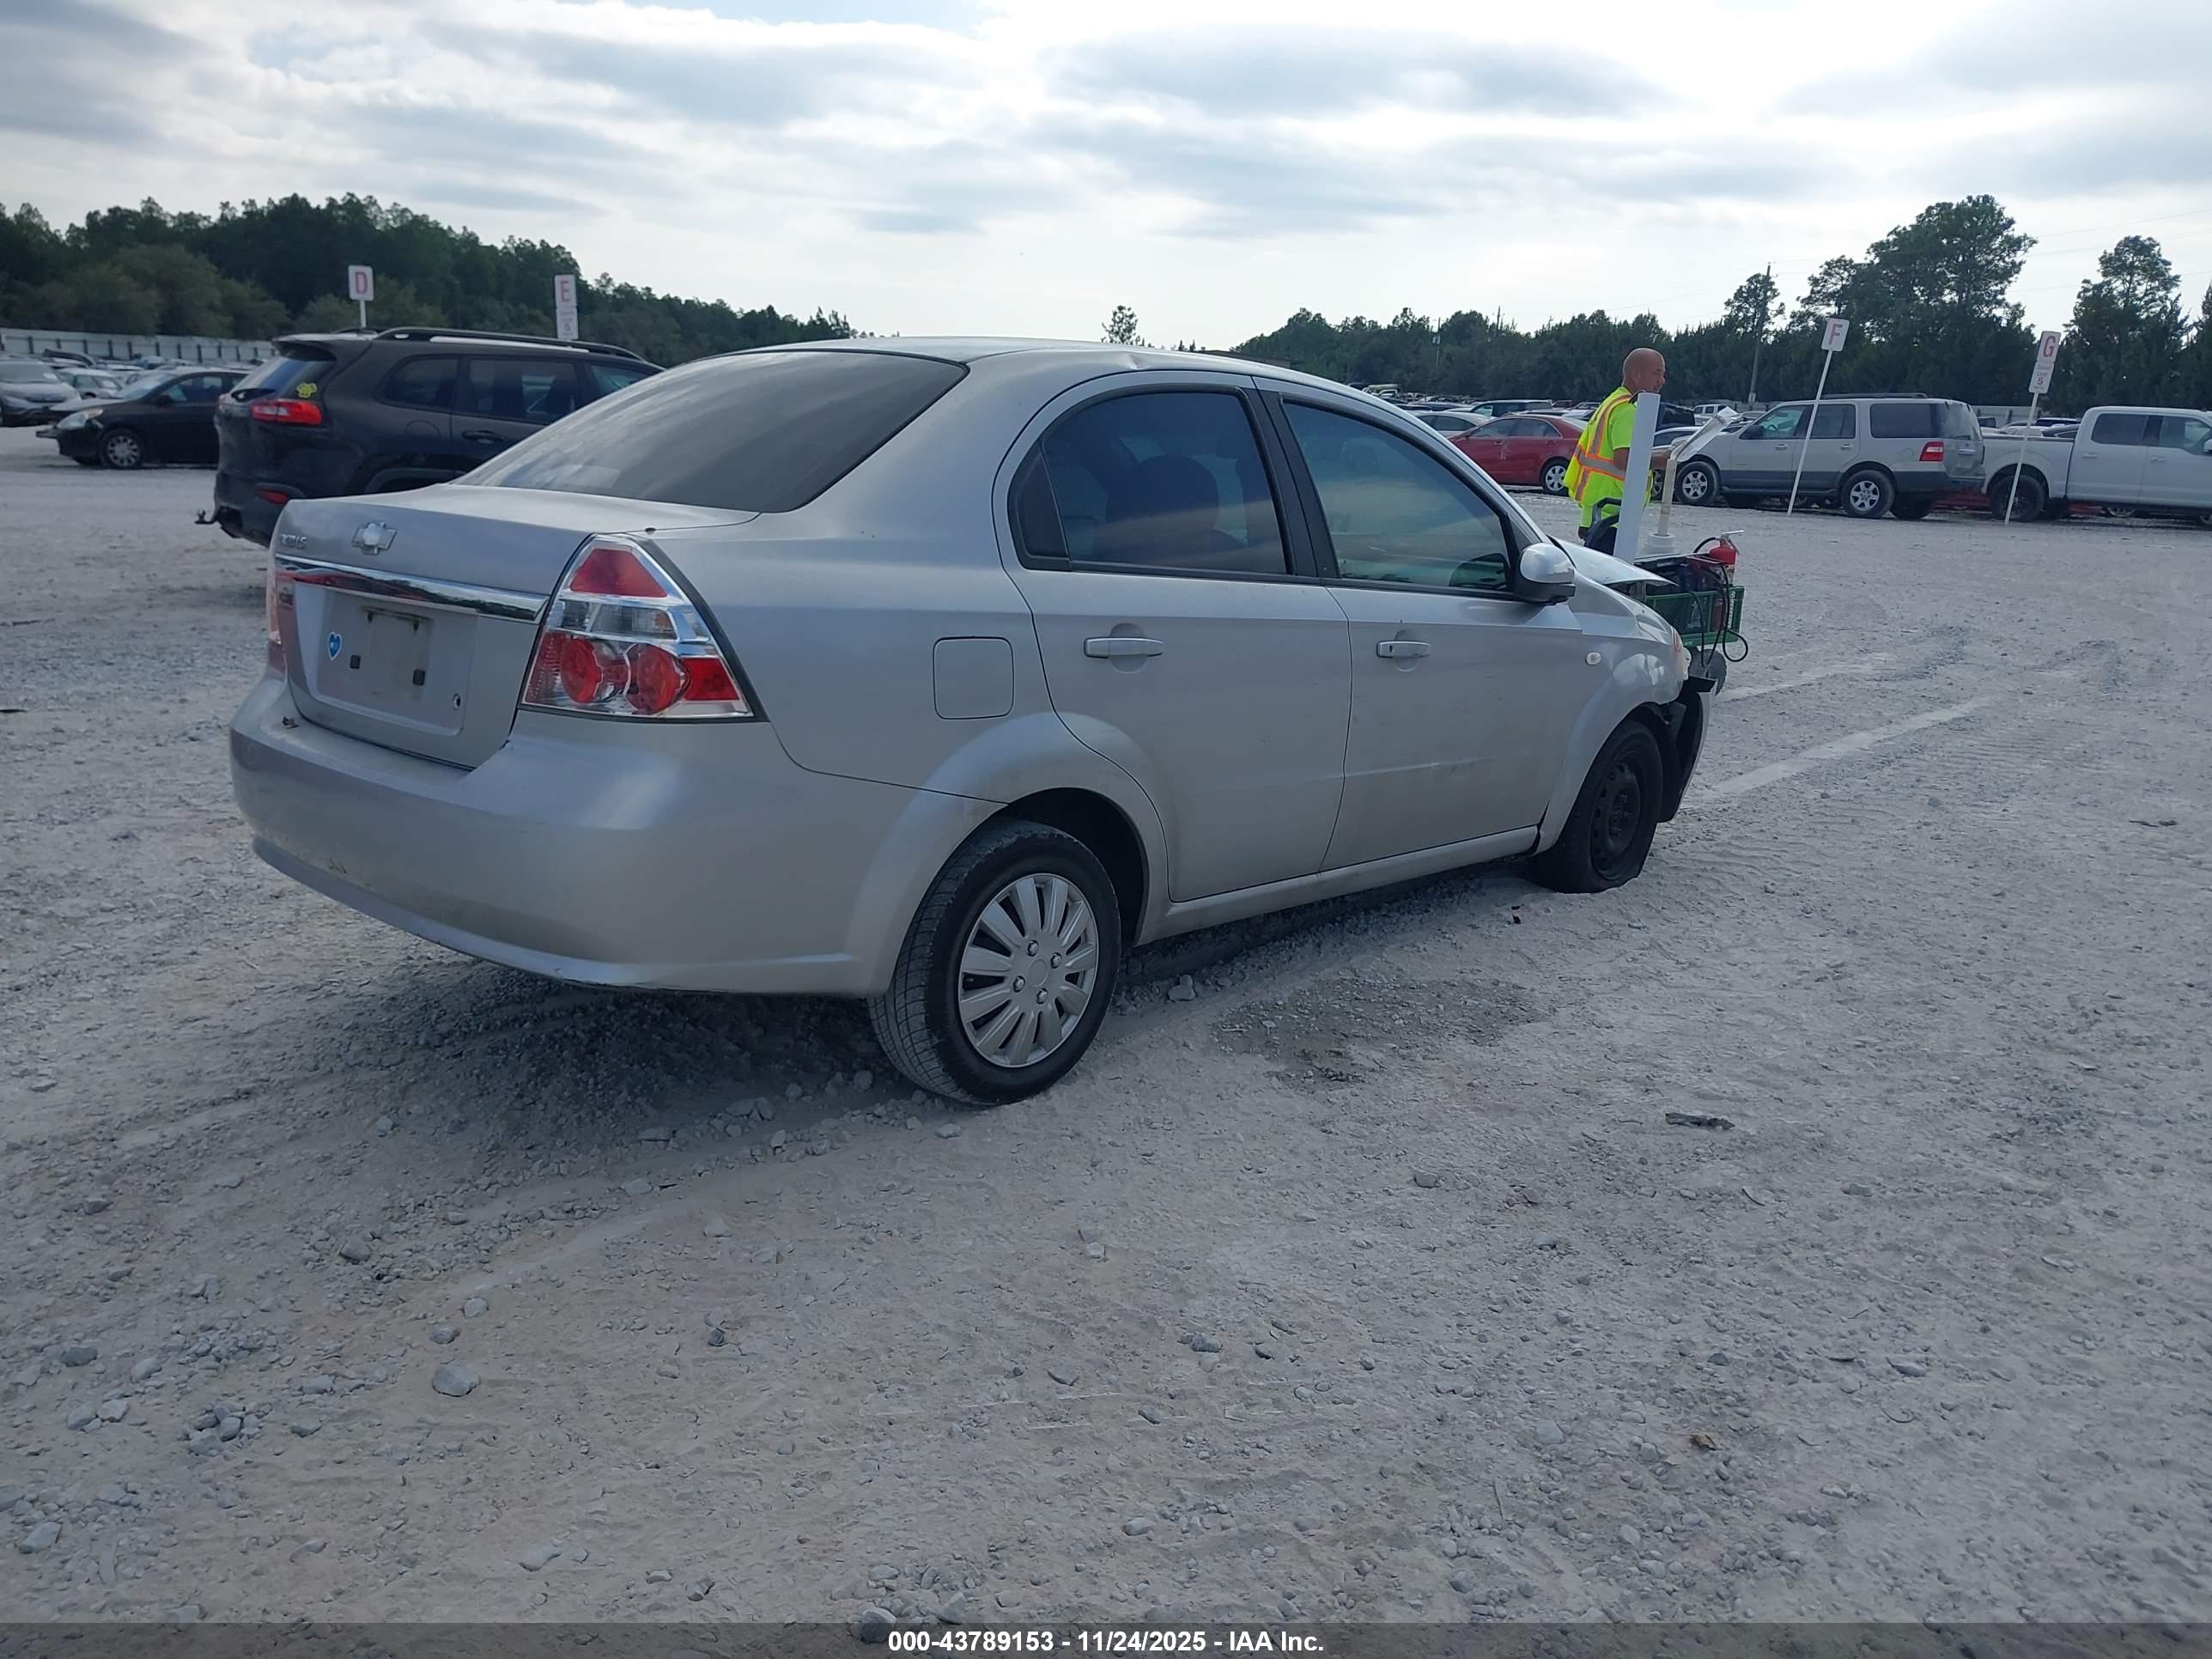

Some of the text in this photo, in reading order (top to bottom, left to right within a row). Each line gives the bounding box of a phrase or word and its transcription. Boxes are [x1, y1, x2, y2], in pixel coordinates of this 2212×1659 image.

[355, 271, 368, 295] D
[560, 281, 571, 303] E
[1828, 323, 1844, 345] F
[2043, 335, 2057, 358] G
[2037, 377, 2044, 386] 5
